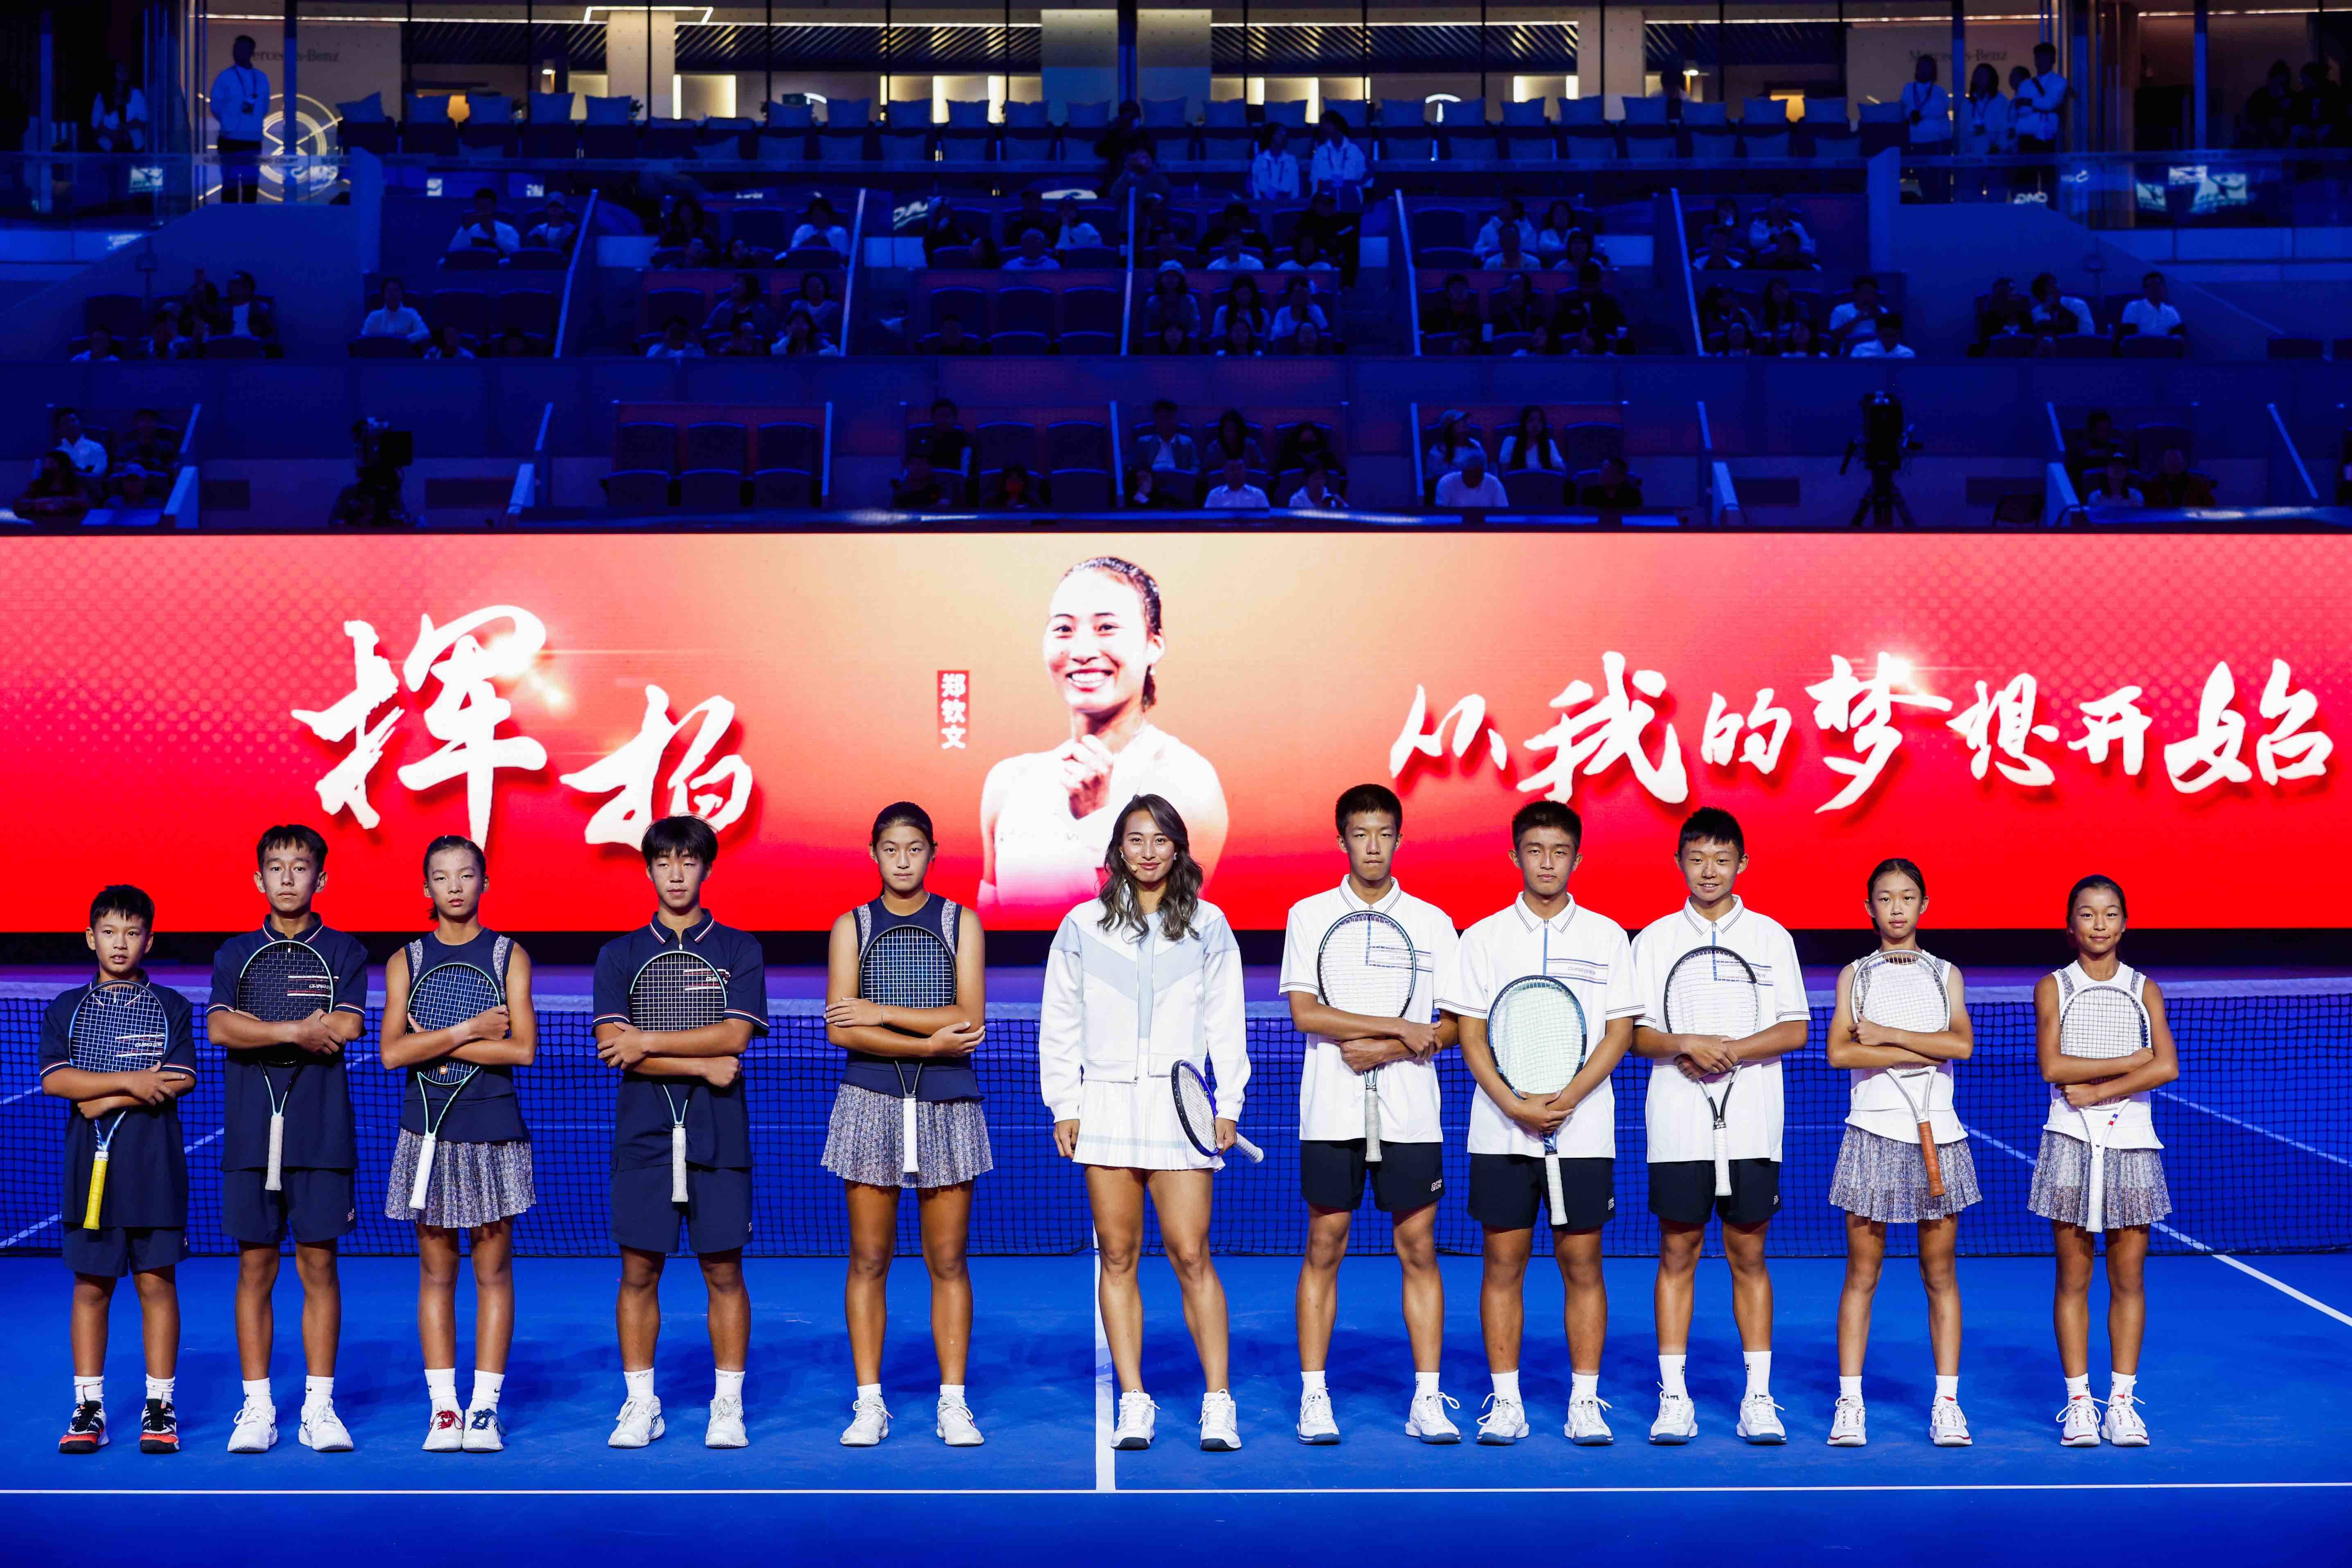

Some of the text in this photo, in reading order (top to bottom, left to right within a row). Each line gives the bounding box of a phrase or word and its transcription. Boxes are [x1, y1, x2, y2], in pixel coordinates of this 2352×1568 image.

[291, 605, 753, 851] 挥拍
[941, 672, 966, 749] 郑钦文
[1390, 651, 2334, 813] 从我的梦想开始
